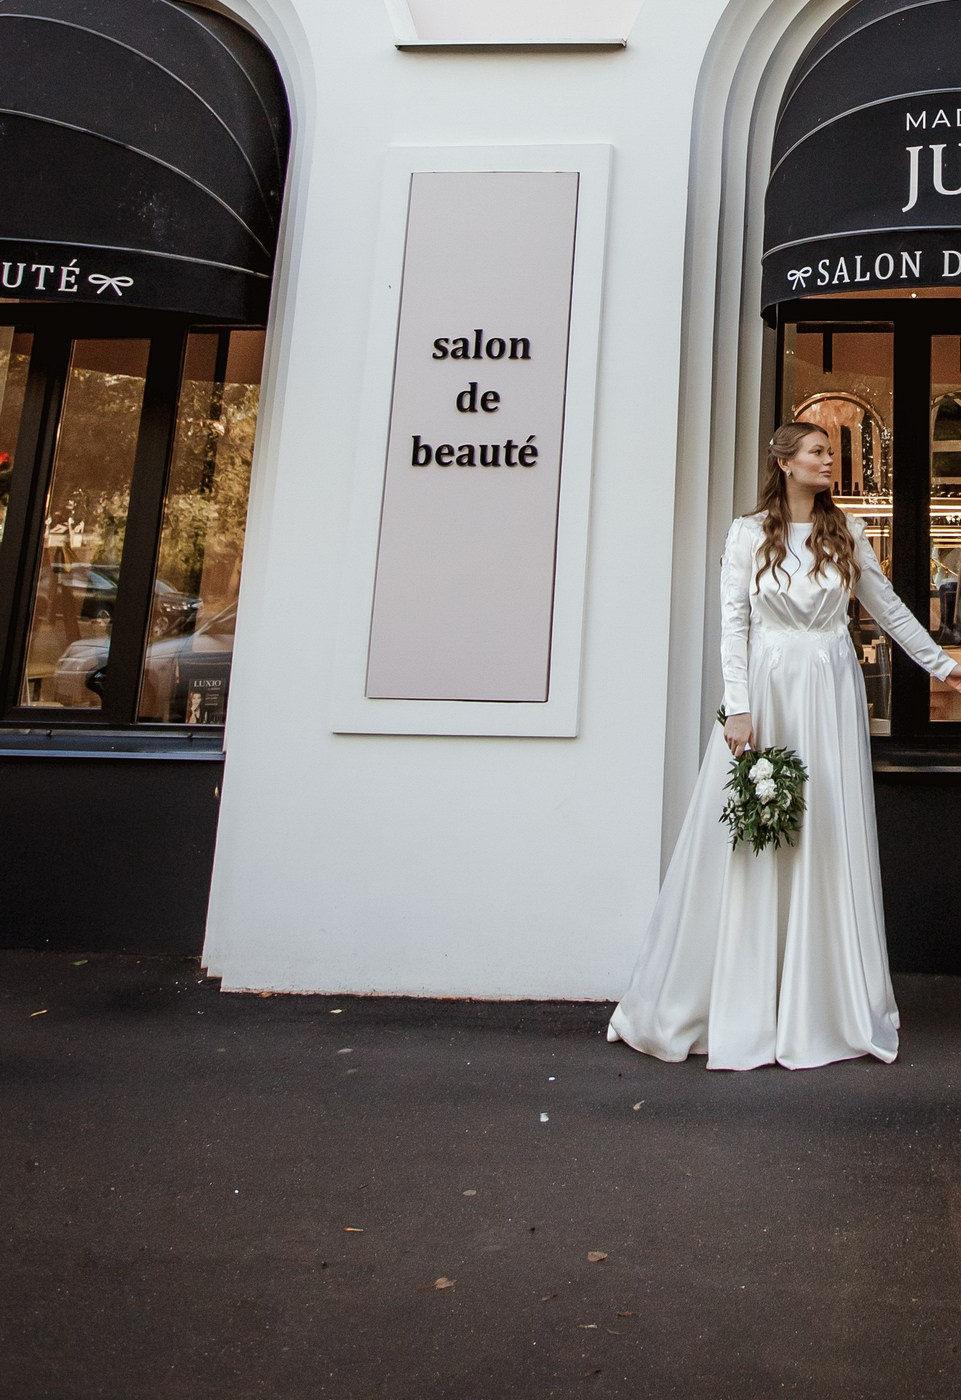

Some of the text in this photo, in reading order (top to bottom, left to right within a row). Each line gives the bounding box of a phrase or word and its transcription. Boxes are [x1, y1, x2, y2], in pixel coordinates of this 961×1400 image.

[2, 258, 80, 292] UTÉ
[816, 251, 923, 286] SALON
[432, 328, 531, 360] salon
[456, 382, 501, 413] de
[411, 434, 539, 467] beauté
